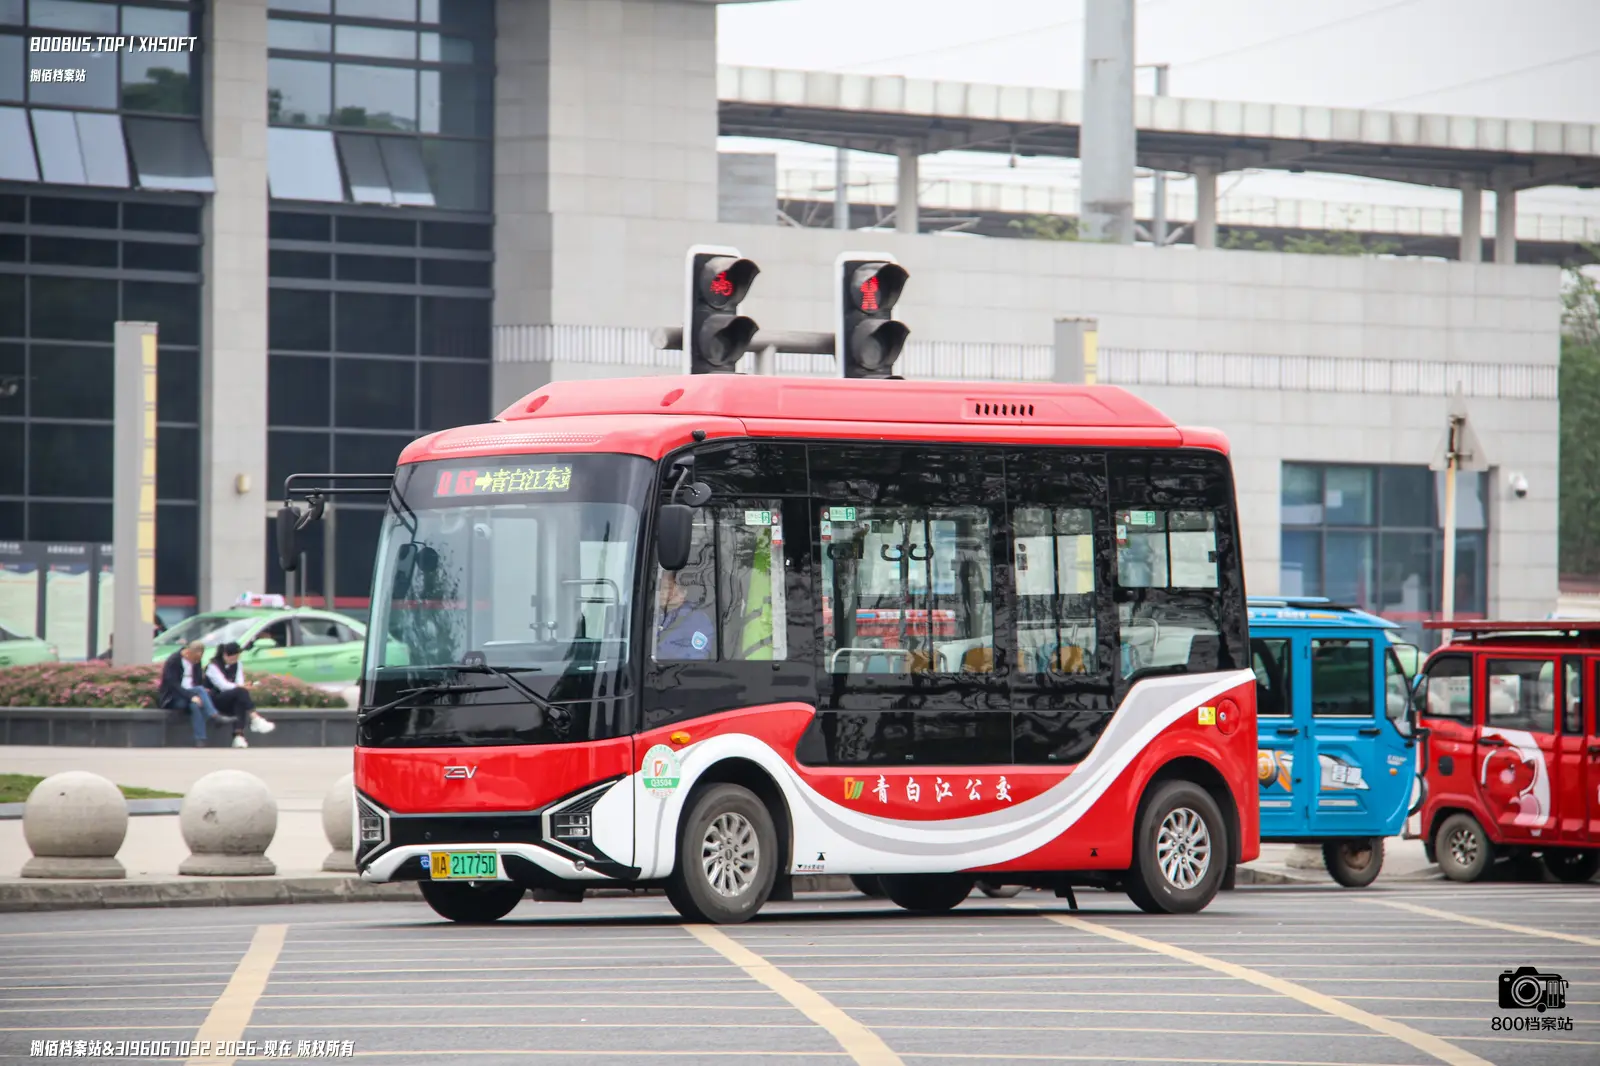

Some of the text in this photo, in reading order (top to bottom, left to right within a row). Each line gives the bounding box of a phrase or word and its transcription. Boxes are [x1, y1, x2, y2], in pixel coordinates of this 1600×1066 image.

[872, 774, 1012, 803] 青白江公交
